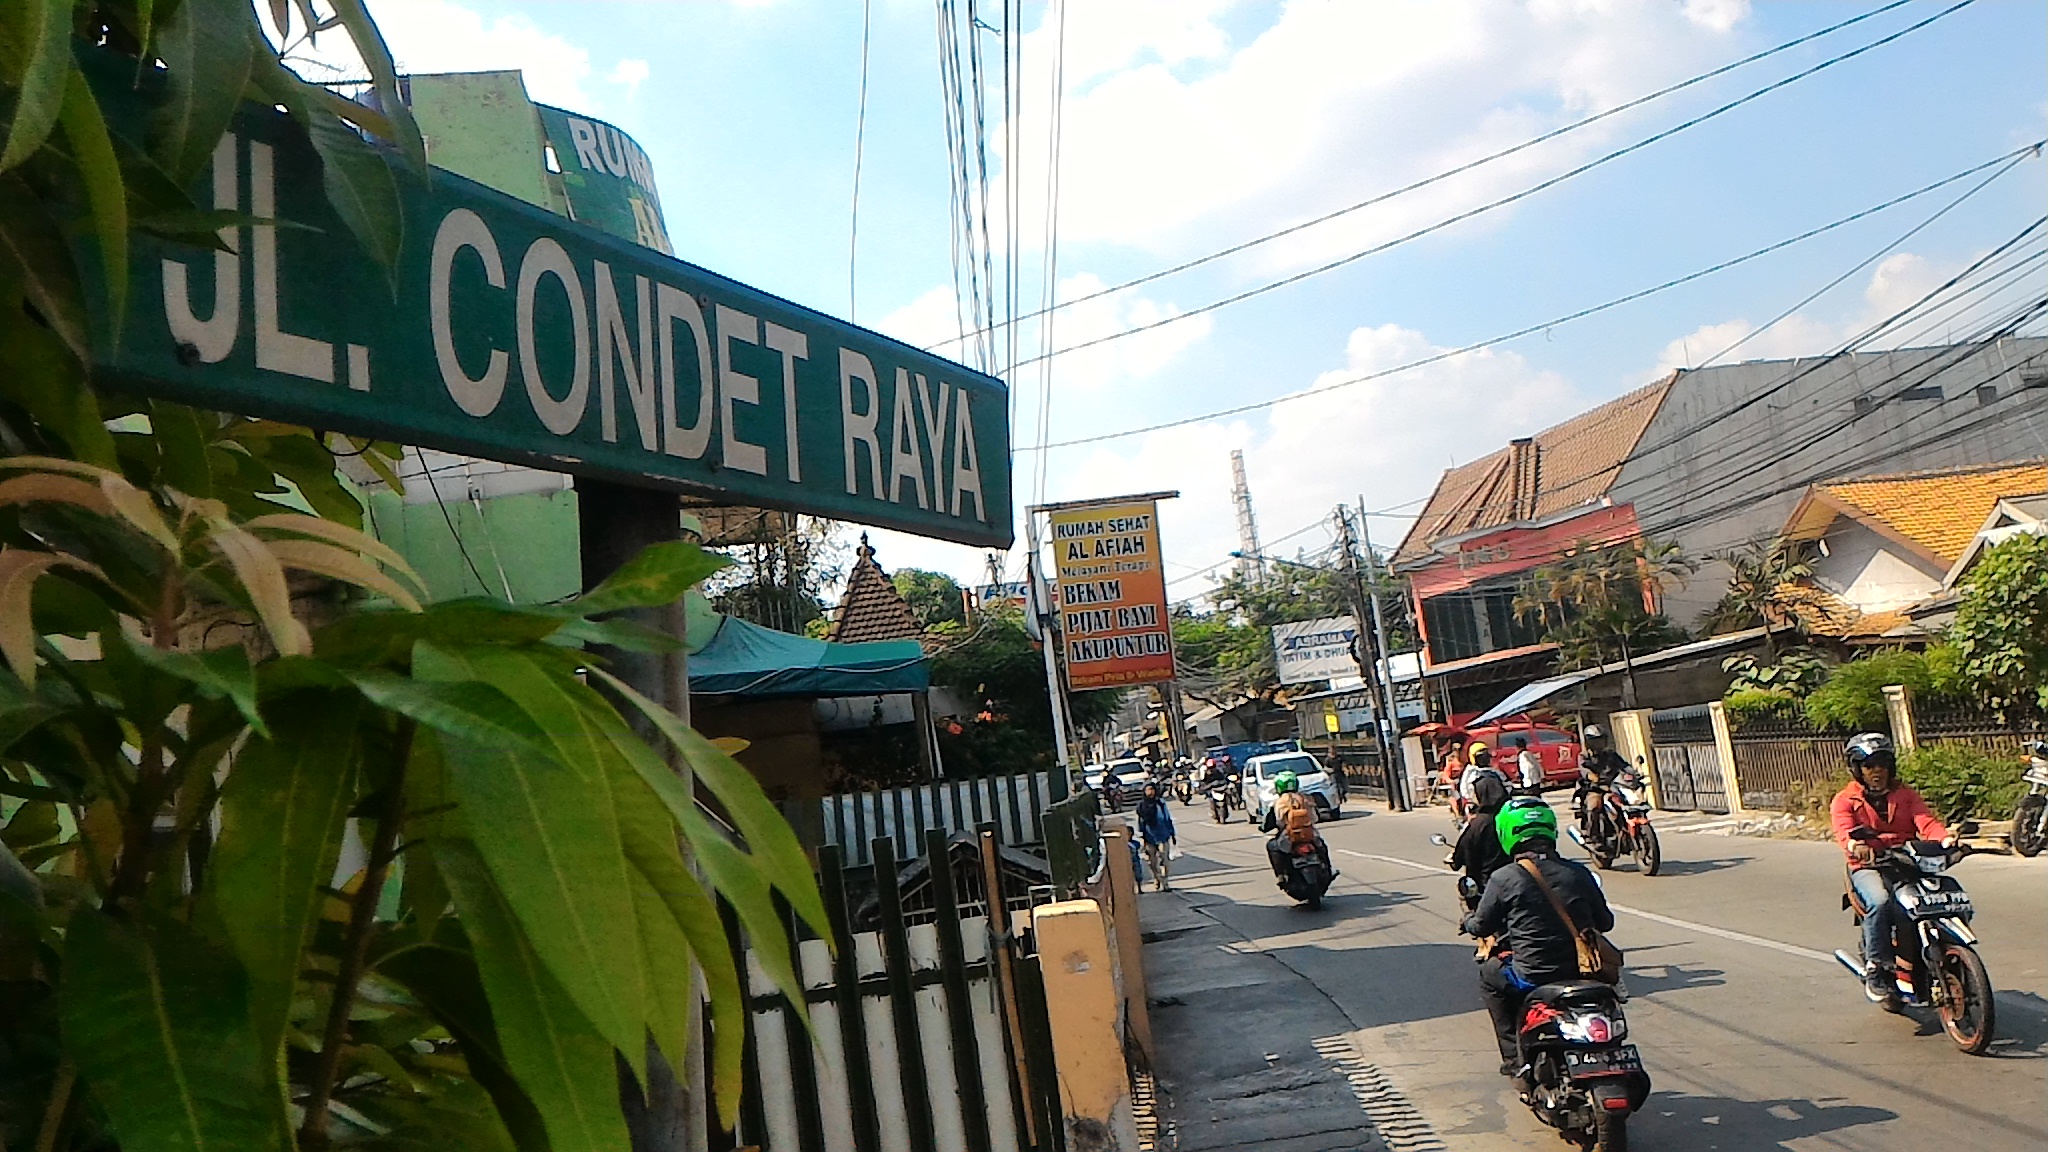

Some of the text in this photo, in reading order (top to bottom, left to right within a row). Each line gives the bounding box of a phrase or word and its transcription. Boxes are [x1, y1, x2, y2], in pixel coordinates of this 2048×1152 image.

[162, 132, 987, 522] JL. CONDET RAYA
[1057, 515, 1151, 539] RUMAH SEHAT
[1068, 536, 1145, 560] AL AFIAH
[1062, 564, 1112, 579] Melayani
[1063, 580, 1122, 604] BEKAM
[1067, 605, 1158, 634] PIJAT BAYI
[1071, 633, 1169, 662] AKUPUNTUR
[1296, 632, 1346, 648] ASRAMA
